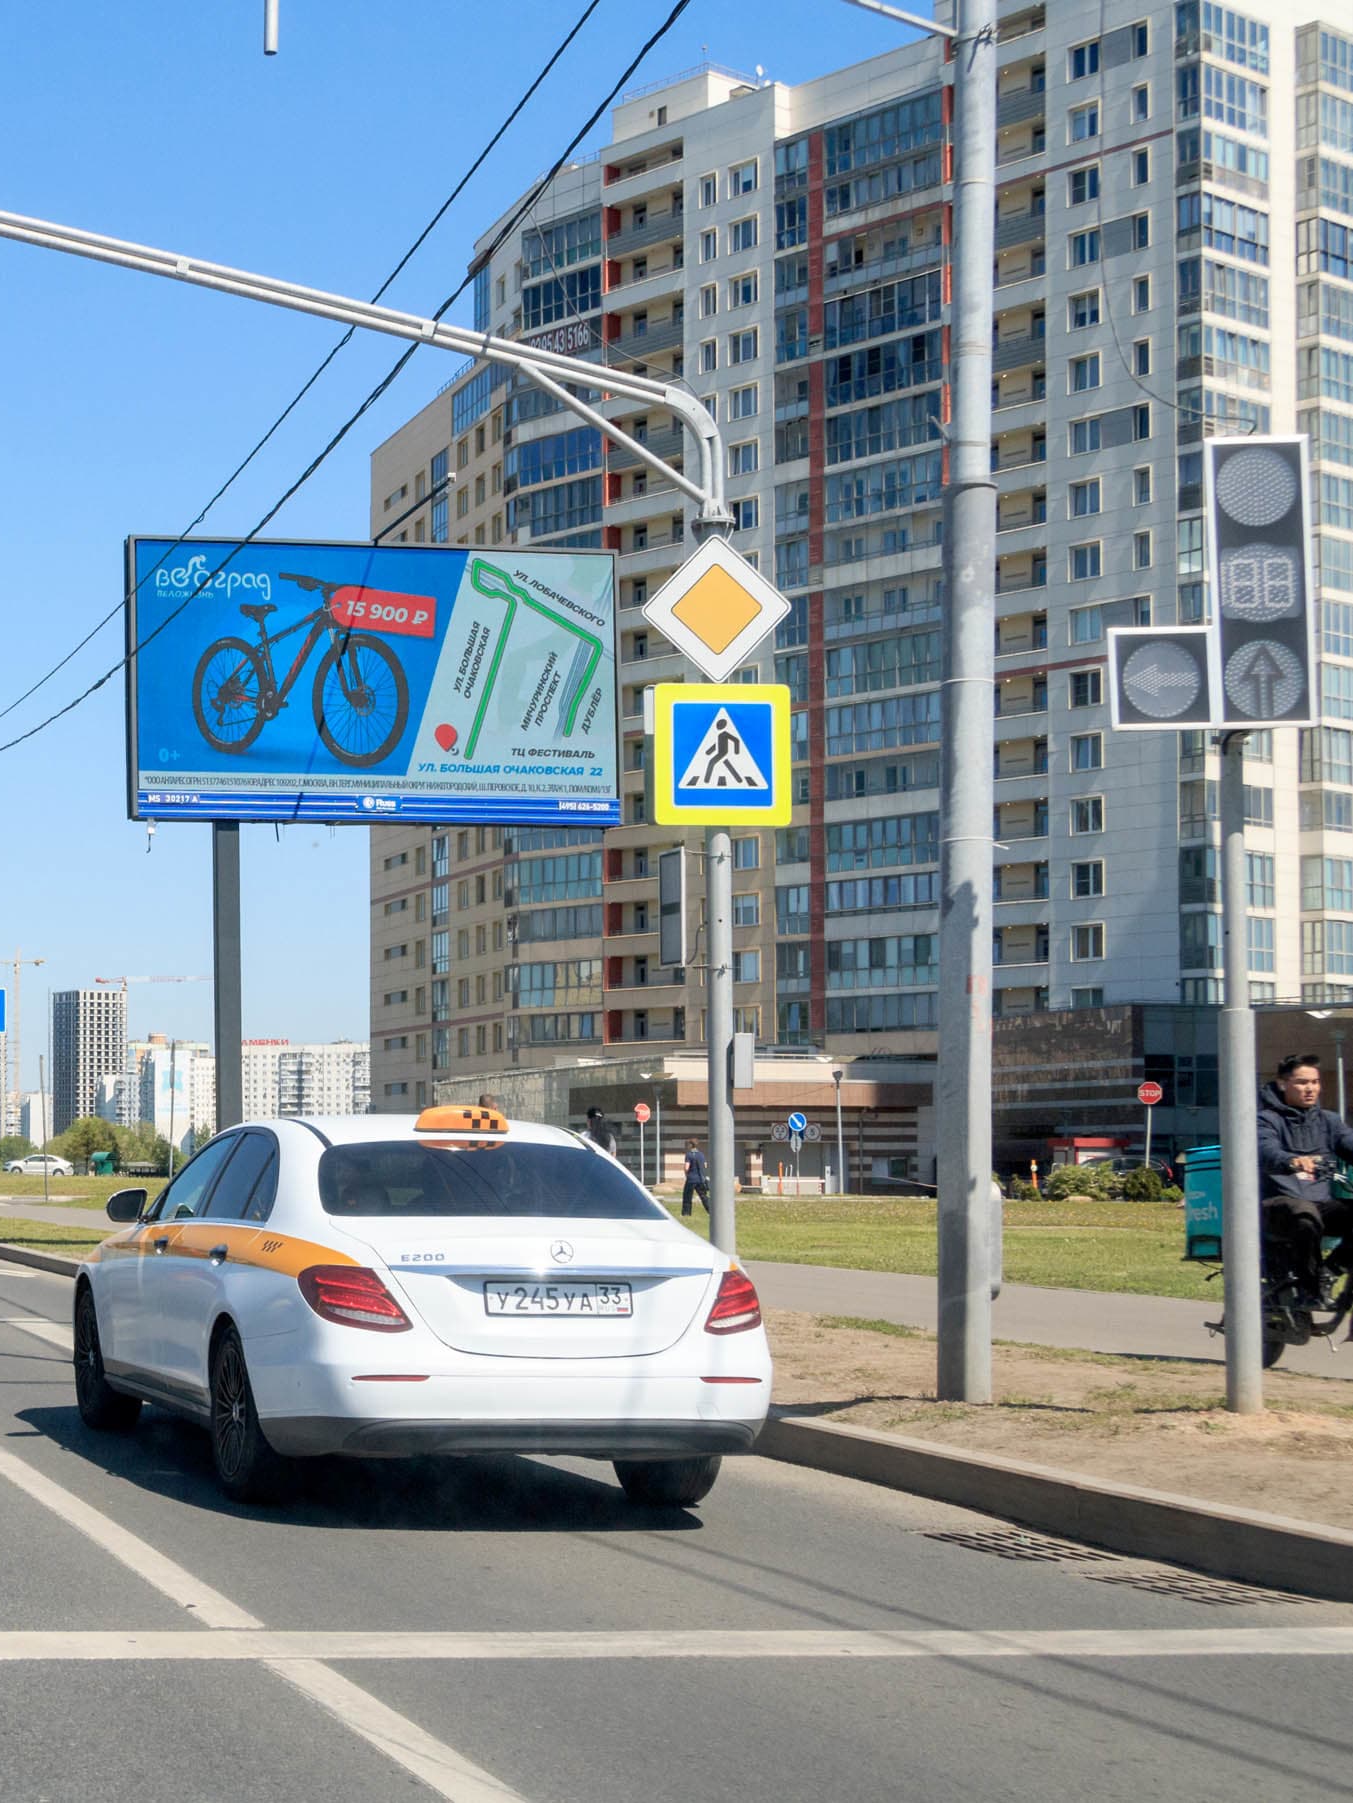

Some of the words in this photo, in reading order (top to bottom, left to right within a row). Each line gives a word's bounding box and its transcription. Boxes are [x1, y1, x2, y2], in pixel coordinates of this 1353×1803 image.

[346, 600, 366, 617] 15
[369, 604, 408, 623] 900
[530, 578, 605, 627] ЛОБАЧЕВСКОГО
[459, 621, 481, 678] БОЛЬШАЯ
[464, 627, 491, 699] ОЧАКОВСКАЯ
[520, 651, 558, 731] МИЧУРИНСКИЙ
[535, 671, 562, 727] ПРОСПЕКТ
[581, 688, 602, 735] ДУБЛЁР
[418, 763, 437, 773] УЛ.
[440, 763, 500, 774] БОЛЬШАЯ
[503, 765, 584, 776] ОЧАКОВСКАЯ
[589, 767, 603, 777] 22
[511, 748, 526, 758] ТЦ
[528, 748, 595, 759] ФЕСТИВАЛЬ
[1138, 1089, 1161, 1097] STOP
